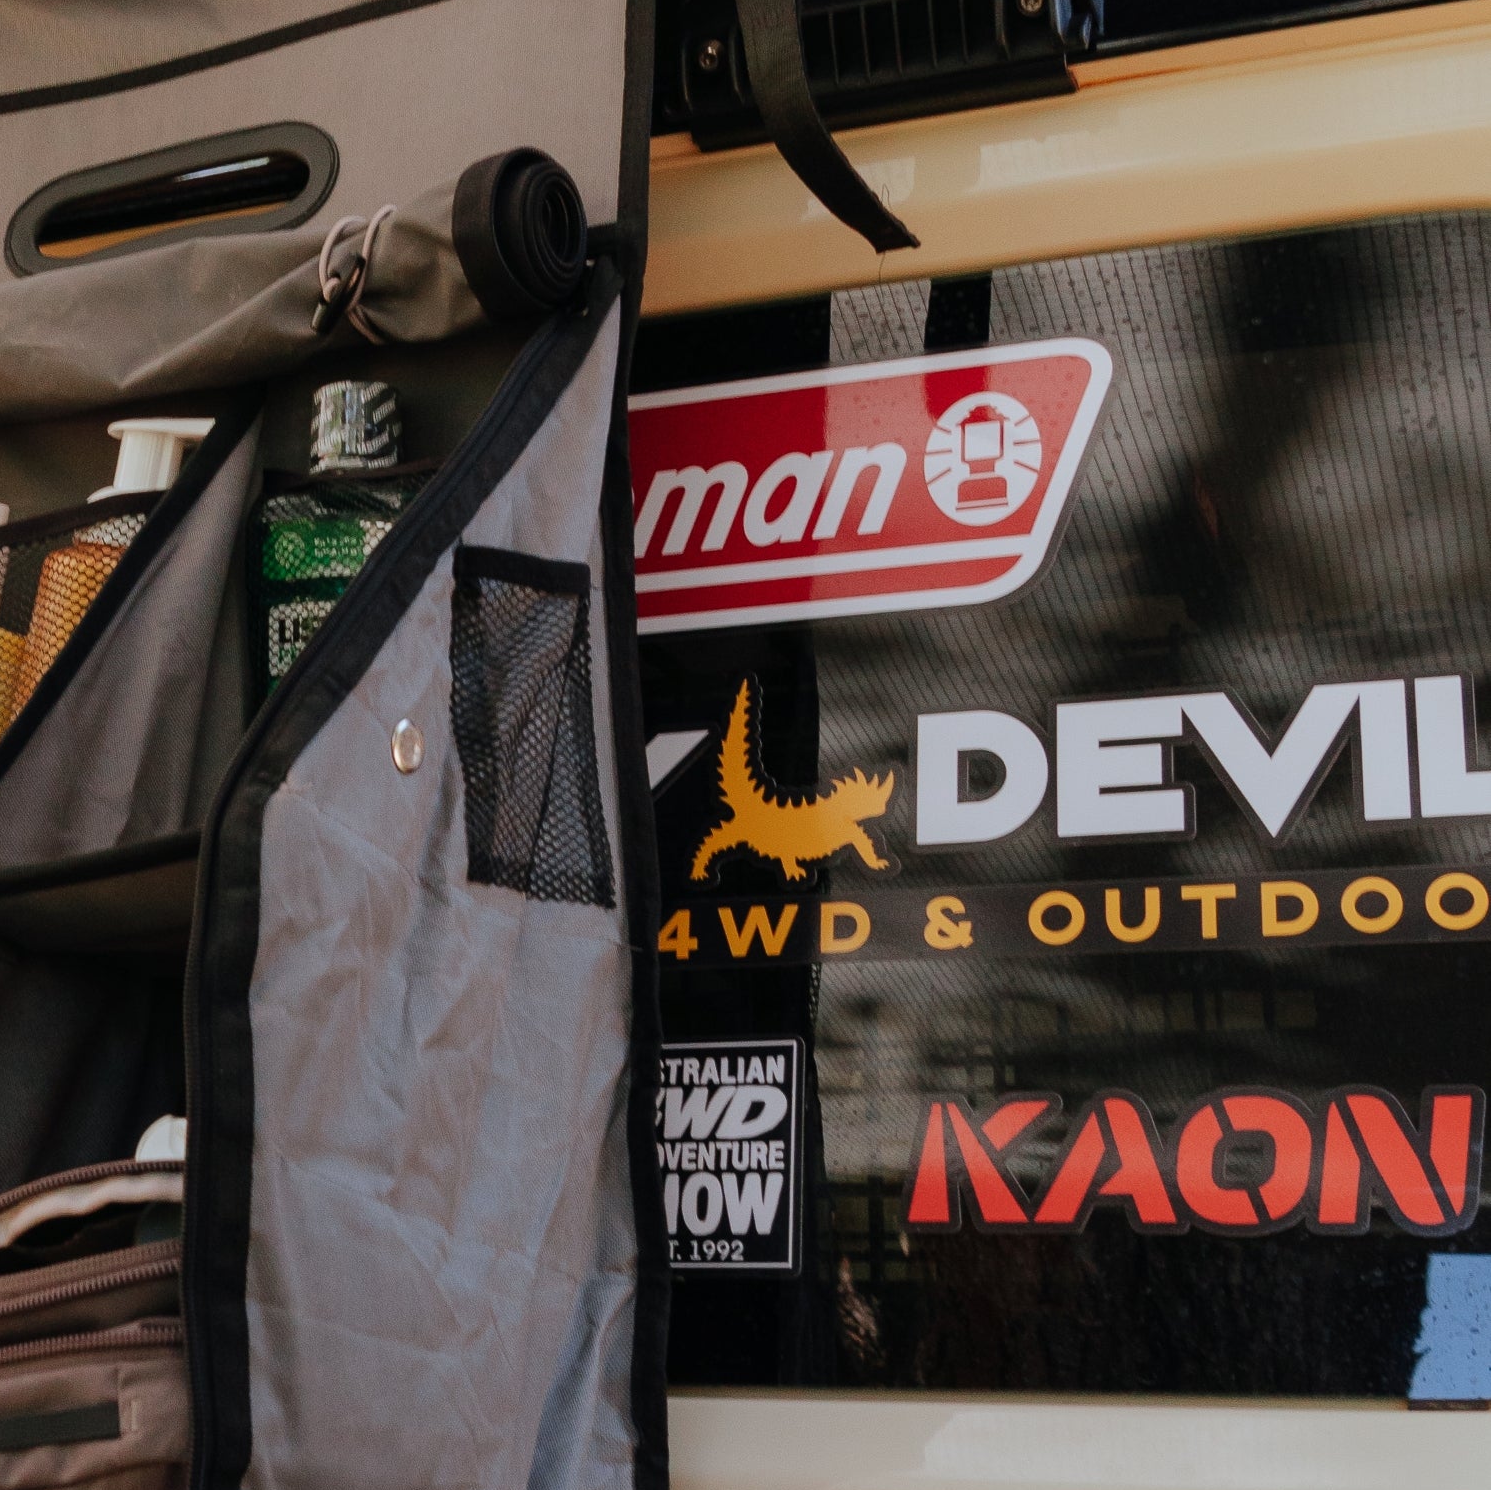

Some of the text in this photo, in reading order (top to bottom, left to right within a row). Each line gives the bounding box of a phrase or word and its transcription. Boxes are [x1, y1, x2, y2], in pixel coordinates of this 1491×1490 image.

[634, 442, 906, 560] man
[916, 675, 1491, 847] DEVIL
[657, 871, 1490, 960] 4WD & OUTDOO
[909, 1093, 1474, 1225] KAON
[689, 1239, 745, 1261] 1992
